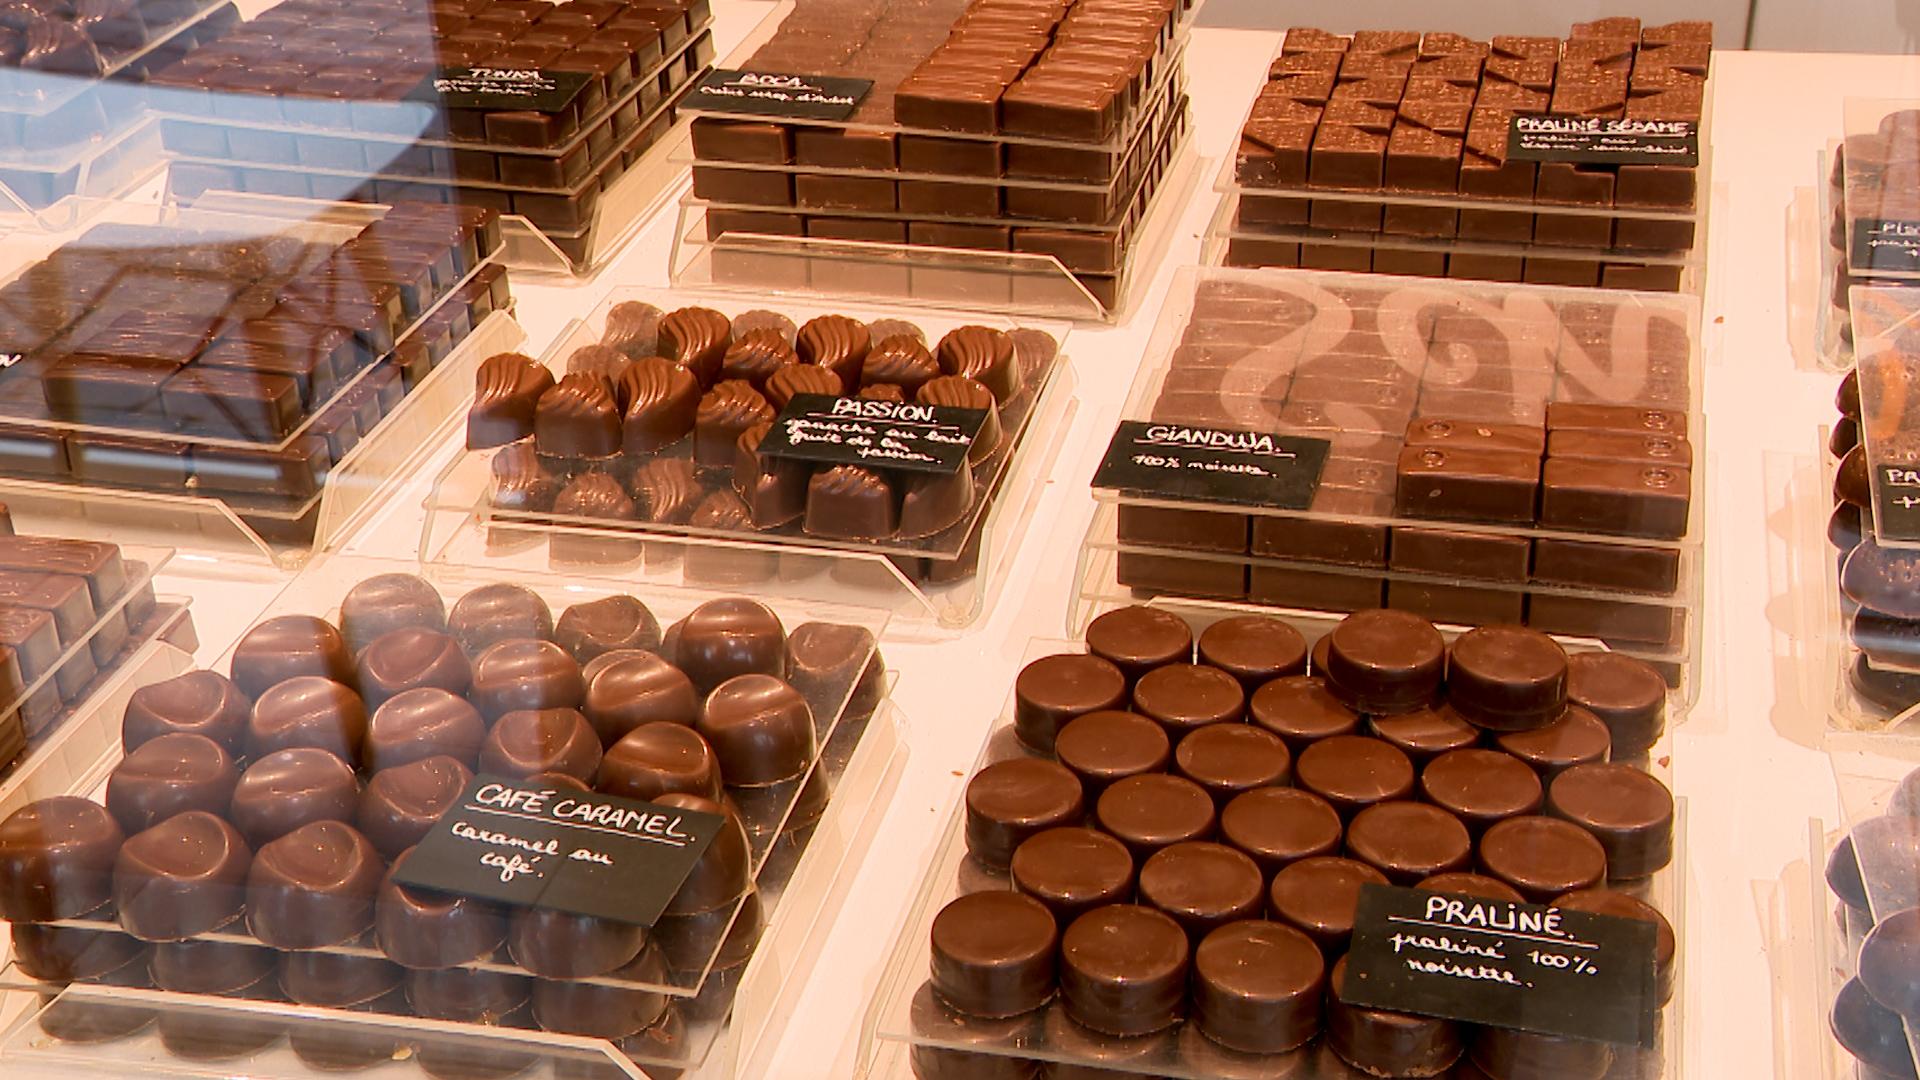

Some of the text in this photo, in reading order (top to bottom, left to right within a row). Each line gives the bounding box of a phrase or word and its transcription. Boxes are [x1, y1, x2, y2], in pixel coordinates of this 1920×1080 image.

[475, 783, 557, 813] CAFÉ
[450, 821, 614, 866] caramel au
[1387, 930, 1599, 976] praliné 100%
